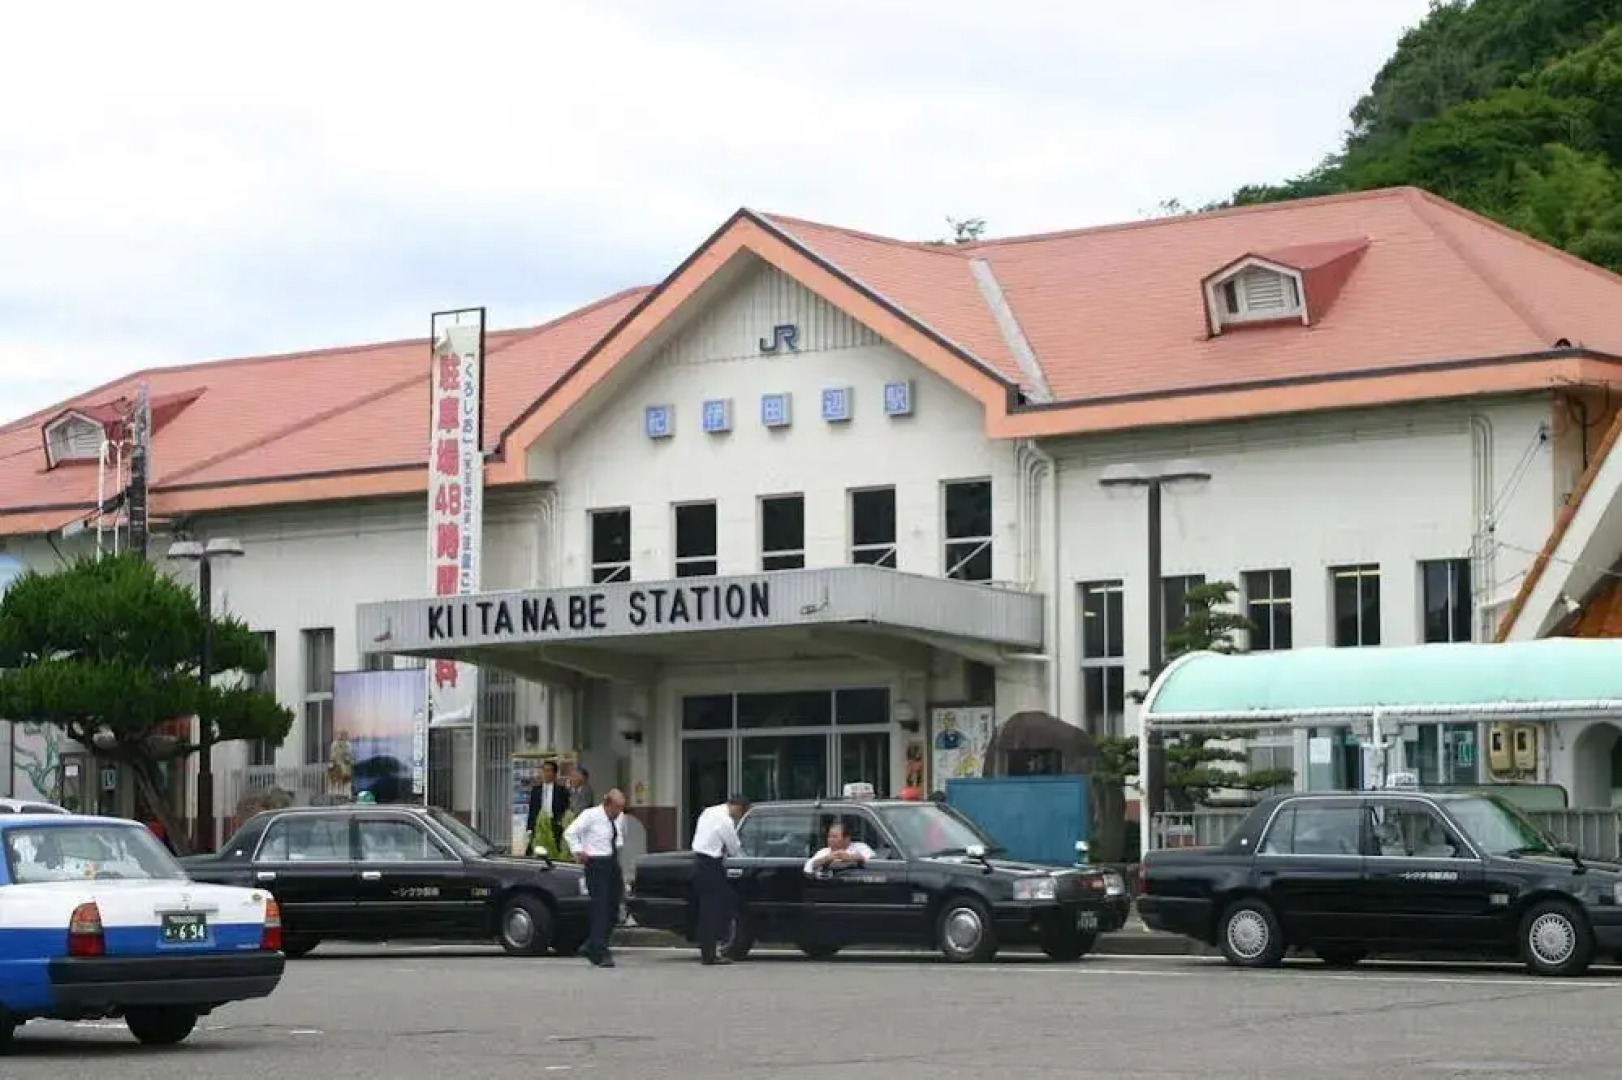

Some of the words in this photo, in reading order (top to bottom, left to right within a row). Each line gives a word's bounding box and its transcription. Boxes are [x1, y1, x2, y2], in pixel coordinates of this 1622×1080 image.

[759, 324, 799, 351] JR
[428, 595, 606, 640] KIITANABE
[629, 582, 770, 626] STATION
